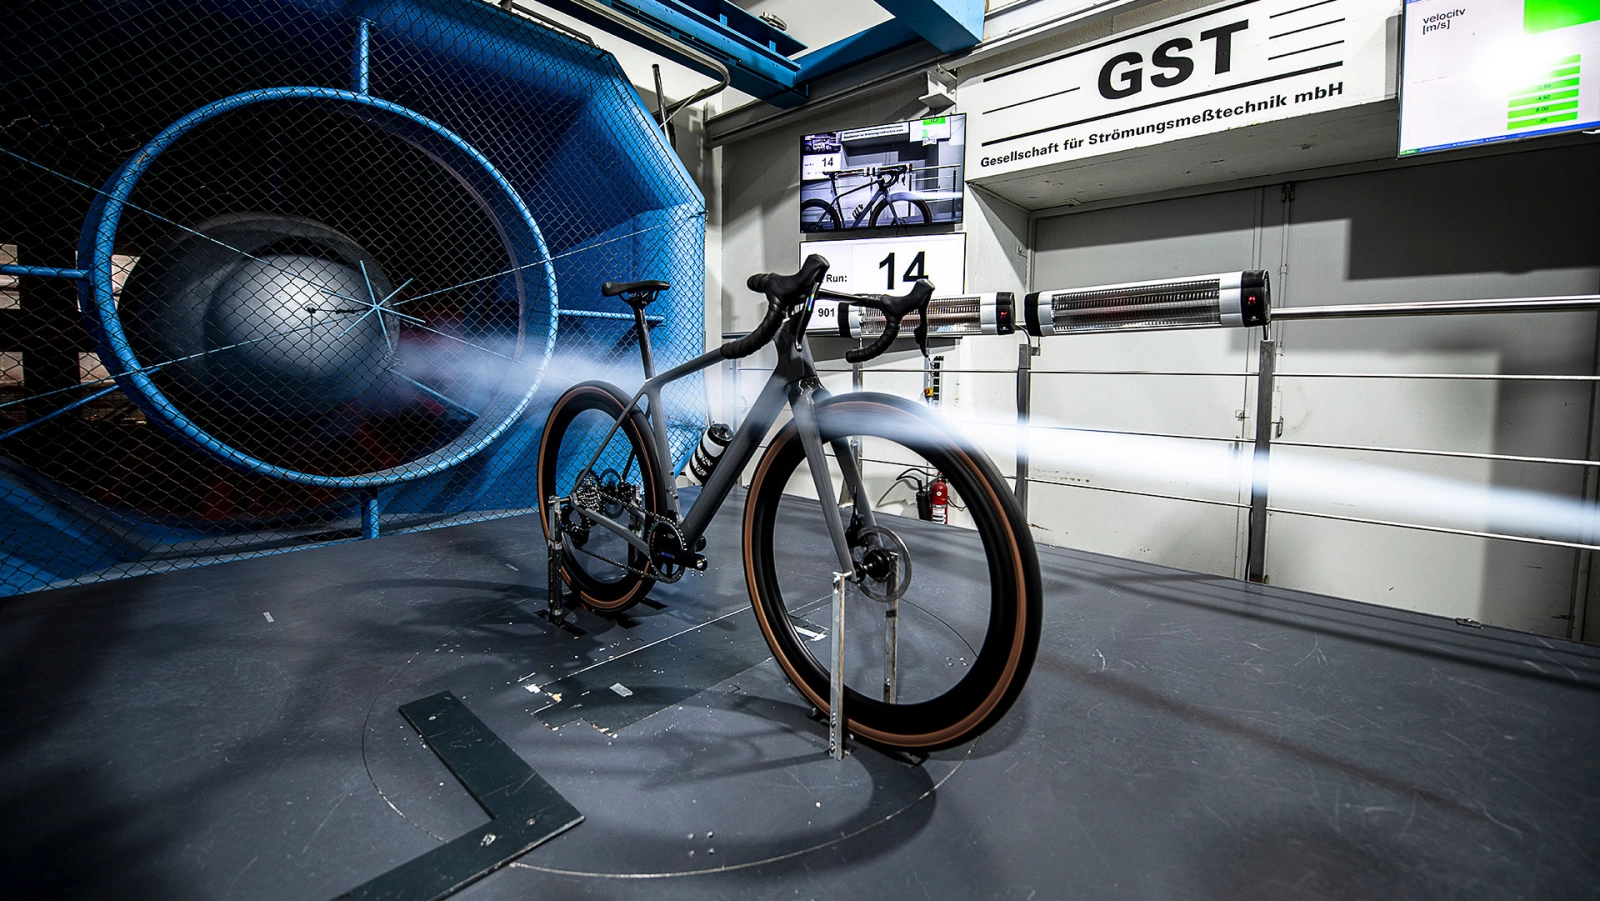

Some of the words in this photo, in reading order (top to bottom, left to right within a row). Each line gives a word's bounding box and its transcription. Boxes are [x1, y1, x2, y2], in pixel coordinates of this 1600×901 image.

[1422, 20, 1451, 35] [m/s]
[1097, 19, 1249, 100] GST
[980, 142, 1060, 168] Gesellschaft
[1063, 136, 1085, 151] für
[1088, 95, 1288, 145] Strömungsmeßtechnik
[1294, 82, 1344, 104] mbH
[821, 157, 834, 168] 14
[826, 274, 848, 283] Run:
[878, 251, 929, 290] 14
[818, 307, 835, 318] 901
